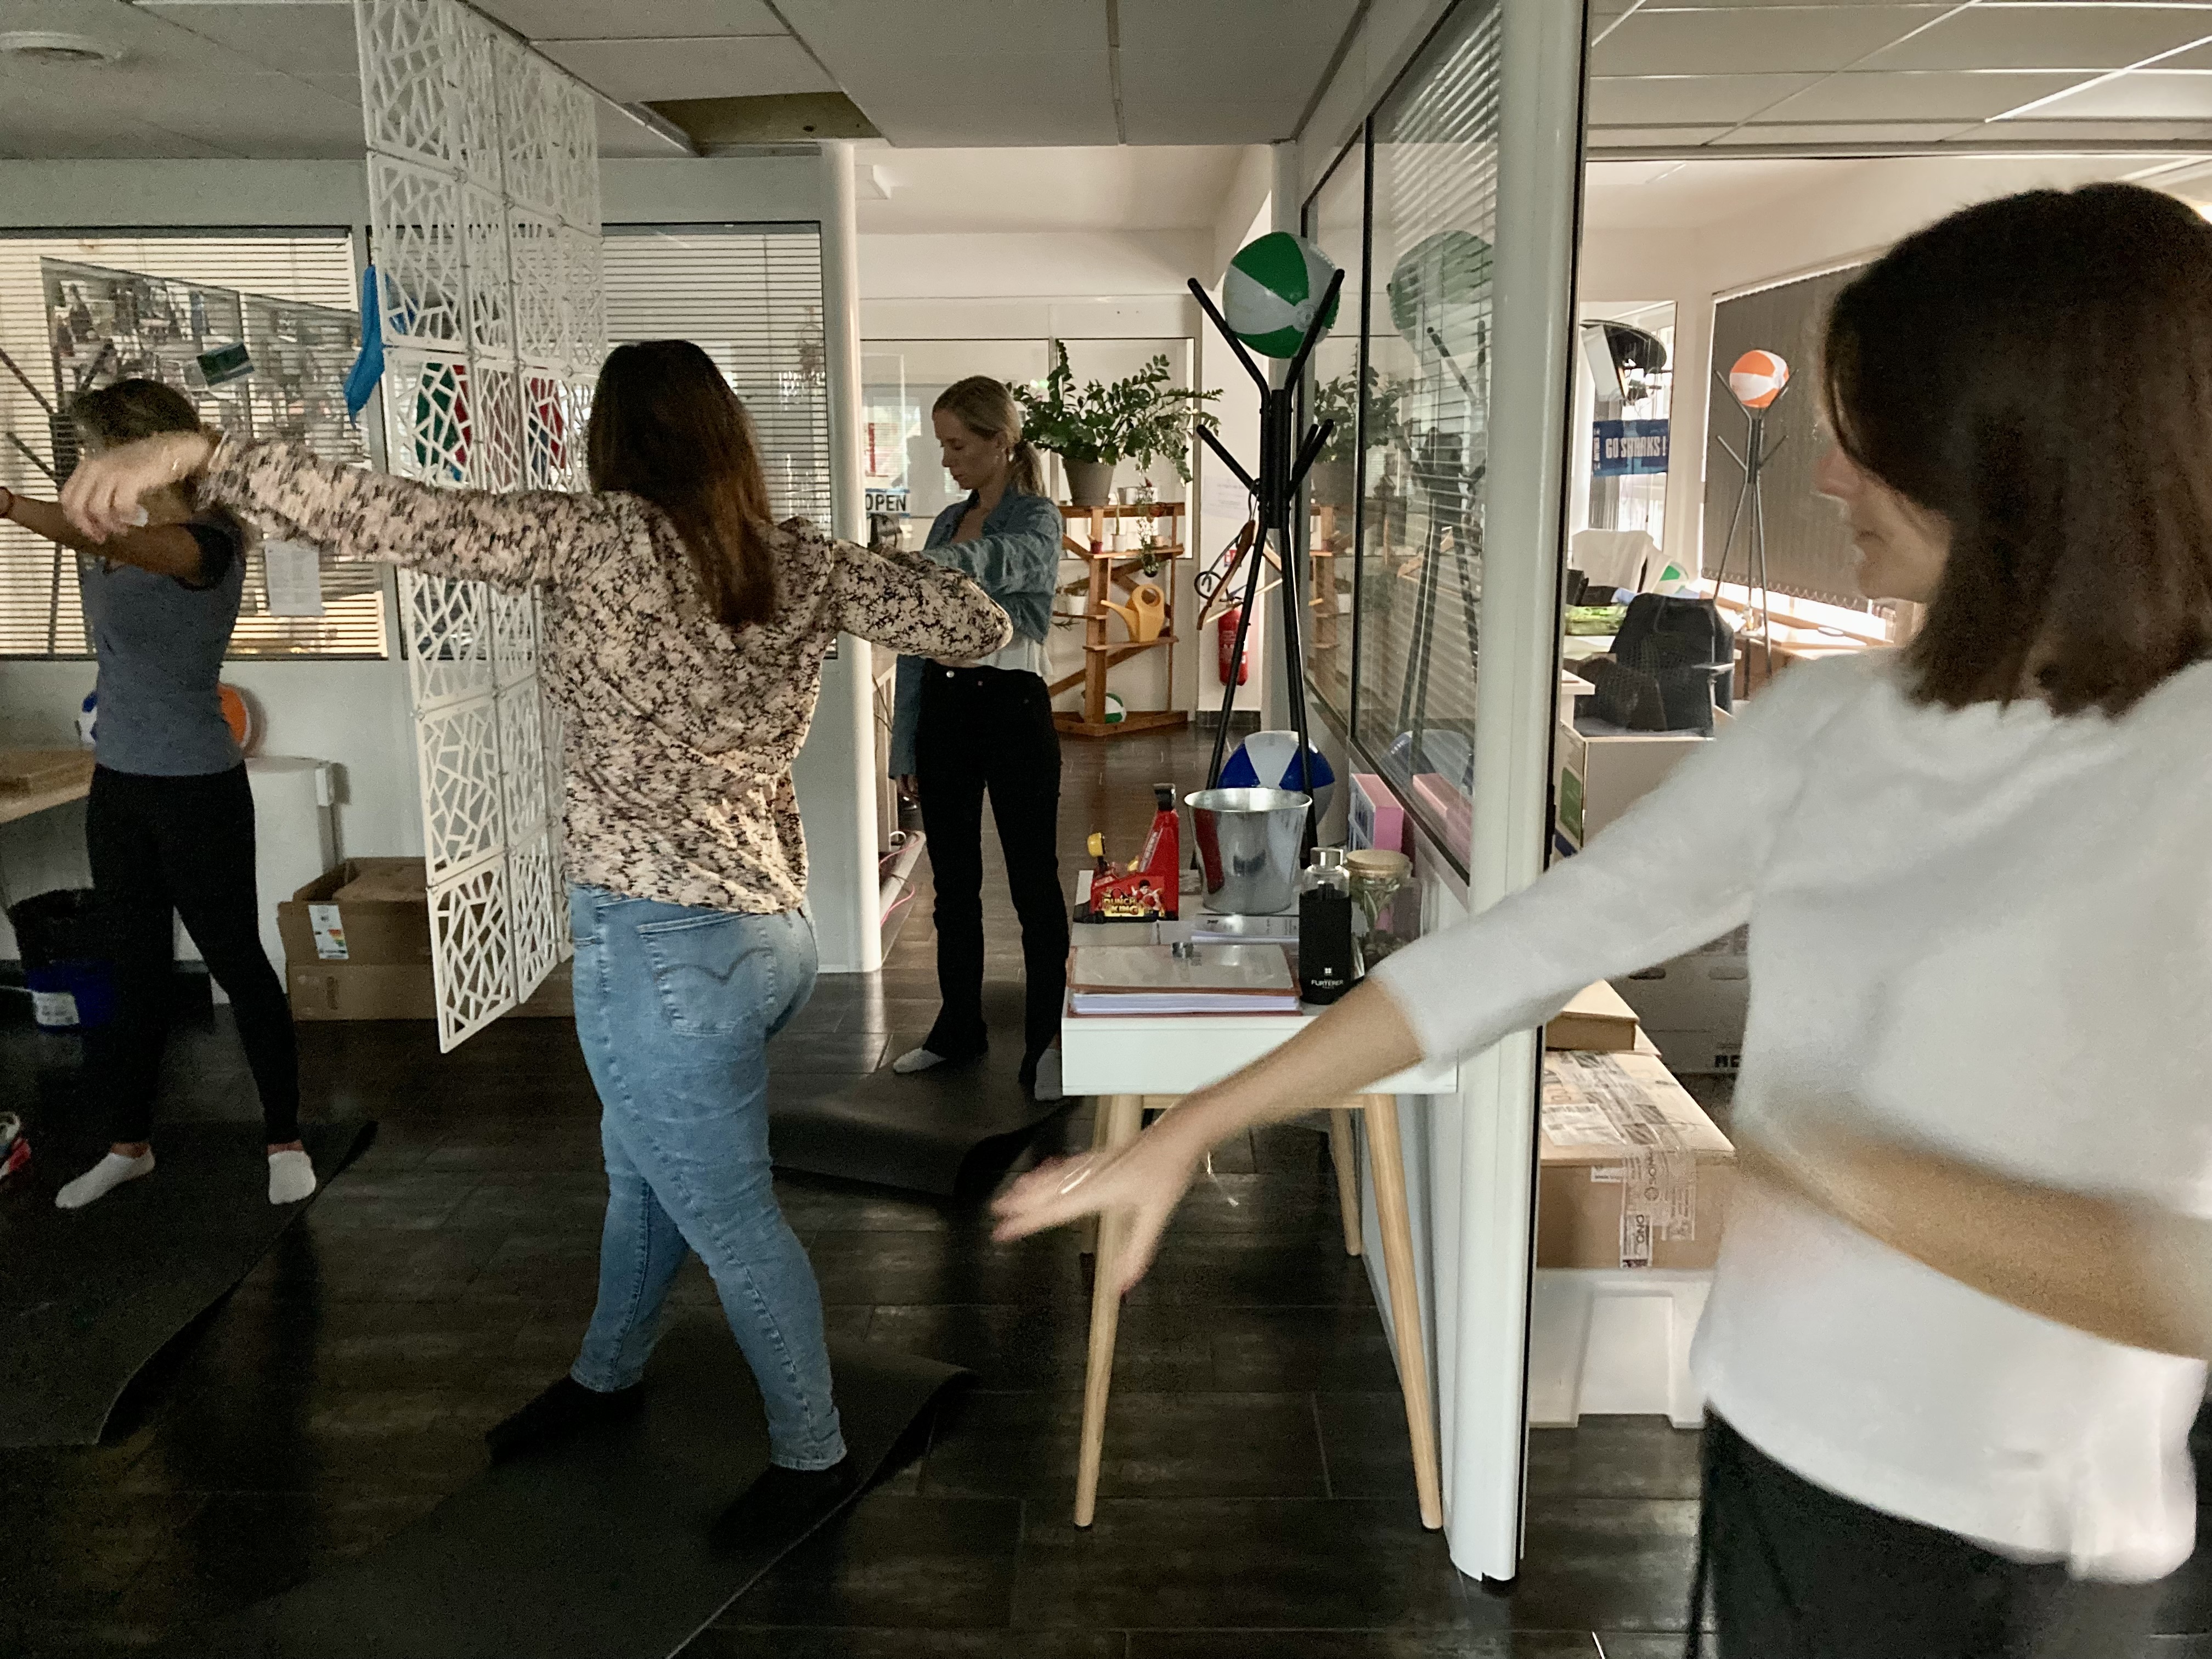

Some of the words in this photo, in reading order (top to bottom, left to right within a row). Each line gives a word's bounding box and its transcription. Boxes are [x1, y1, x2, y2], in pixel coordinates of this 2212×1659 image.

[1605, 438, 1619, 459] GO
[1621, 436, 1661, 458] SHARKS
[865, 494, 906, 511] OPEN
[1110, 905, 1139, 915] KING
